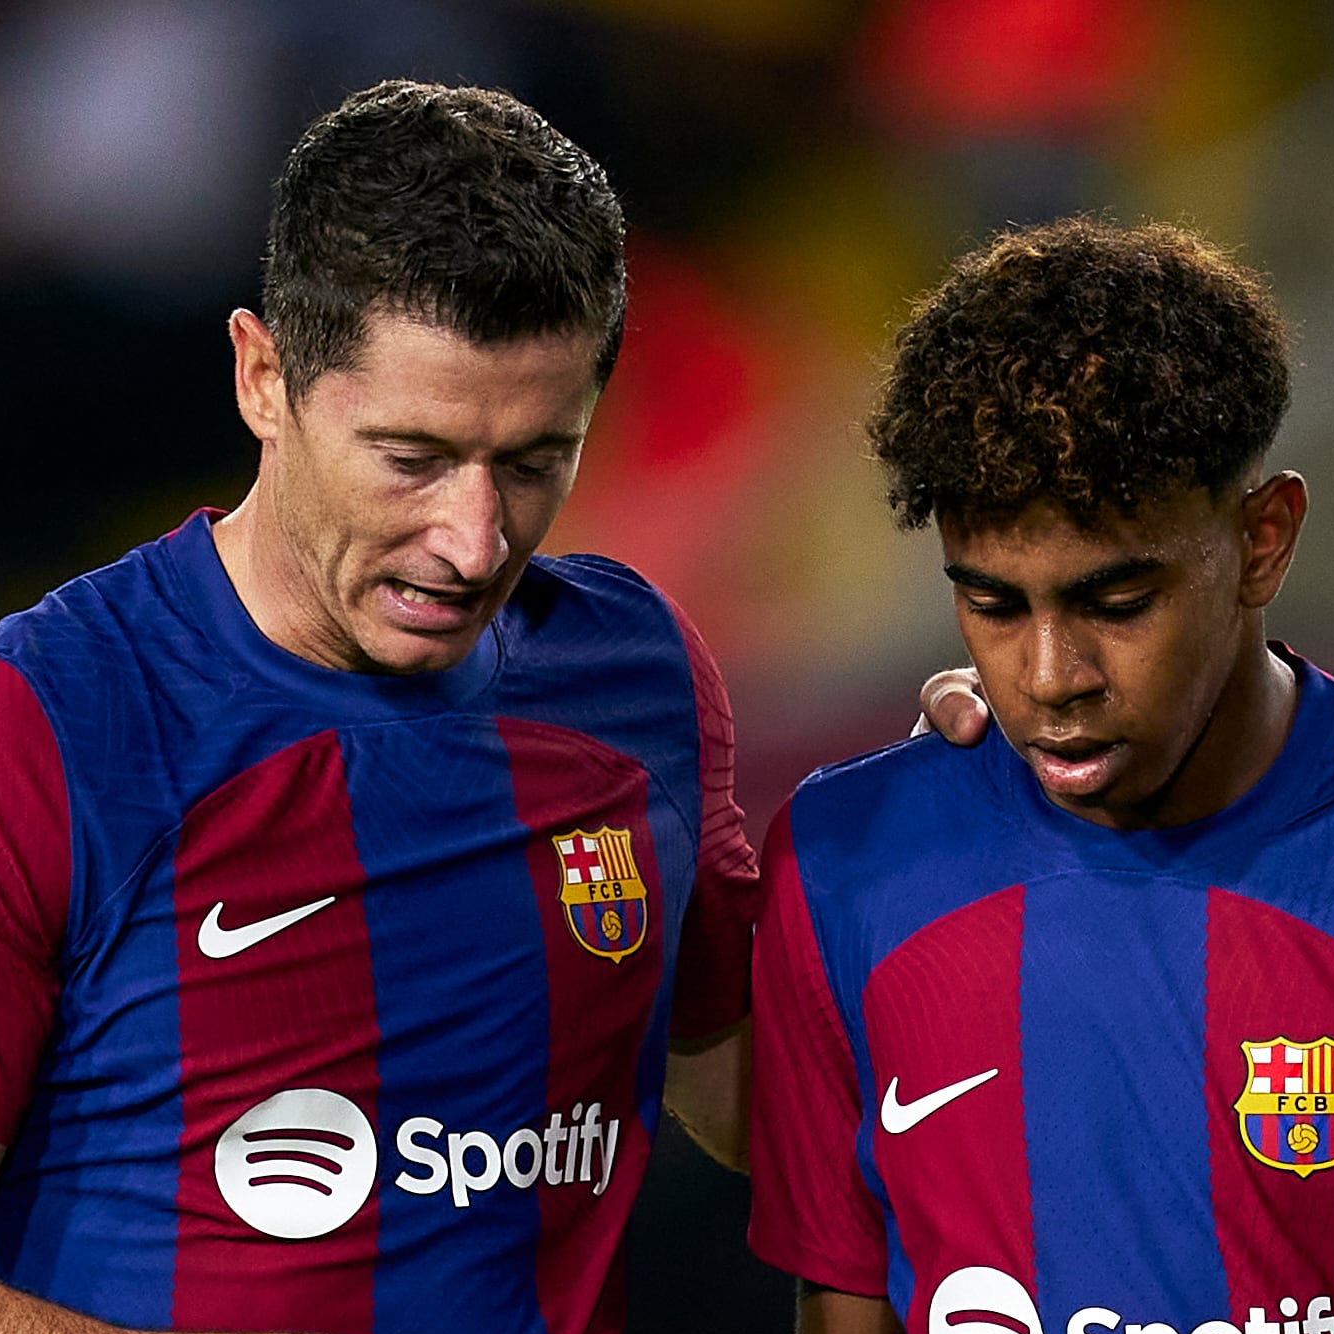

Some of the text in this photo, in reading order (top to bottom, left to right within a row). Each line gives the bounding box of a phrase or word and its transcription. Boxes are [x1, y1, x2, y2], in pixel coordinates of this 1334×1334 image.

[588, 882, 623, 900] FCB
[1278, 1096, 1327, 1111] FCB
[394, 1102, 619, 1208] Spotify
